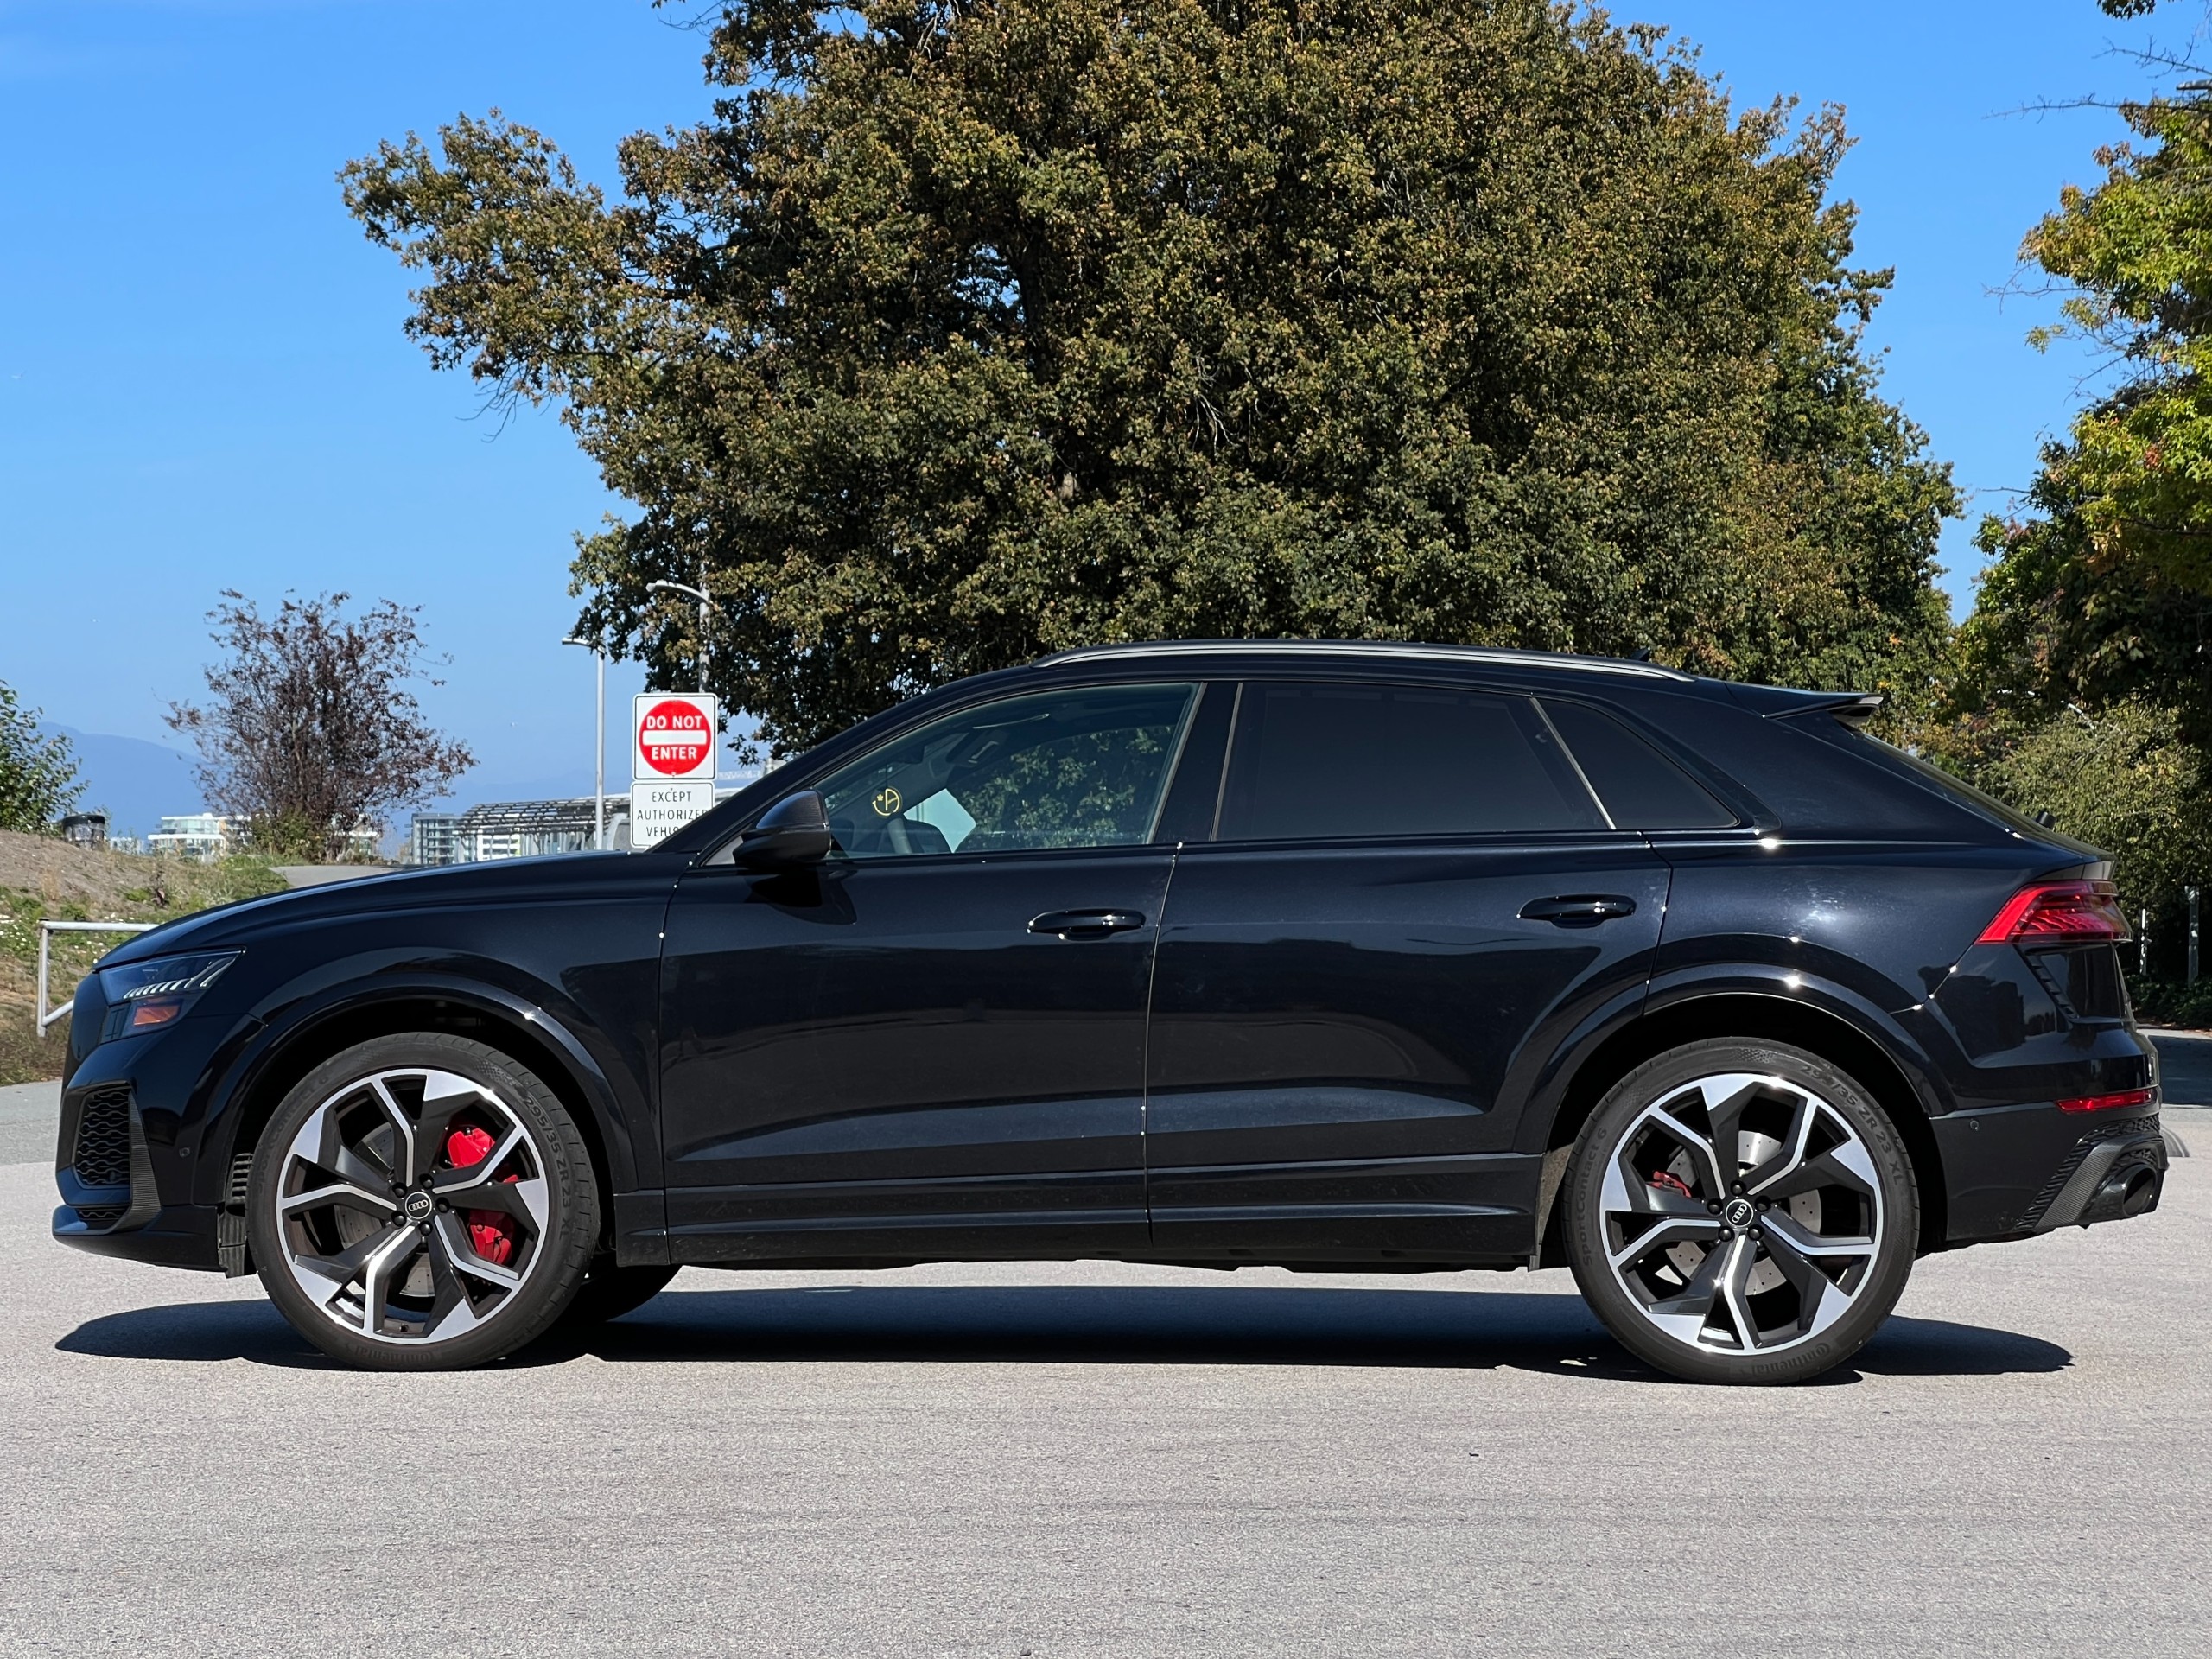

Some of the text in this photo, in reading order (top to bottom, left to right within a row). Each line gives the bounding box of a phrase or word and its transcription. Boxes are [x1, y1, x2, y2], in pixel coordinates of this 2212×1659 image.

[646, 715, 702, 729] DO NOT
[652, 747, 697, 760] ENTER
[652, 791, 692, 803] EXCEPT
[523, 1096, 562, 1154] 295/35
[1858, 1106, 1878, 1130] ZR
[1875, 1131, 1891, 1154] 23
[1890, 1160, 1904, 1185] XL
[556, 1158, 569, 1182] ZR
[561, 1185, 572, 1208] 23
[1577, 1144, 1599, 1266] SportContact
